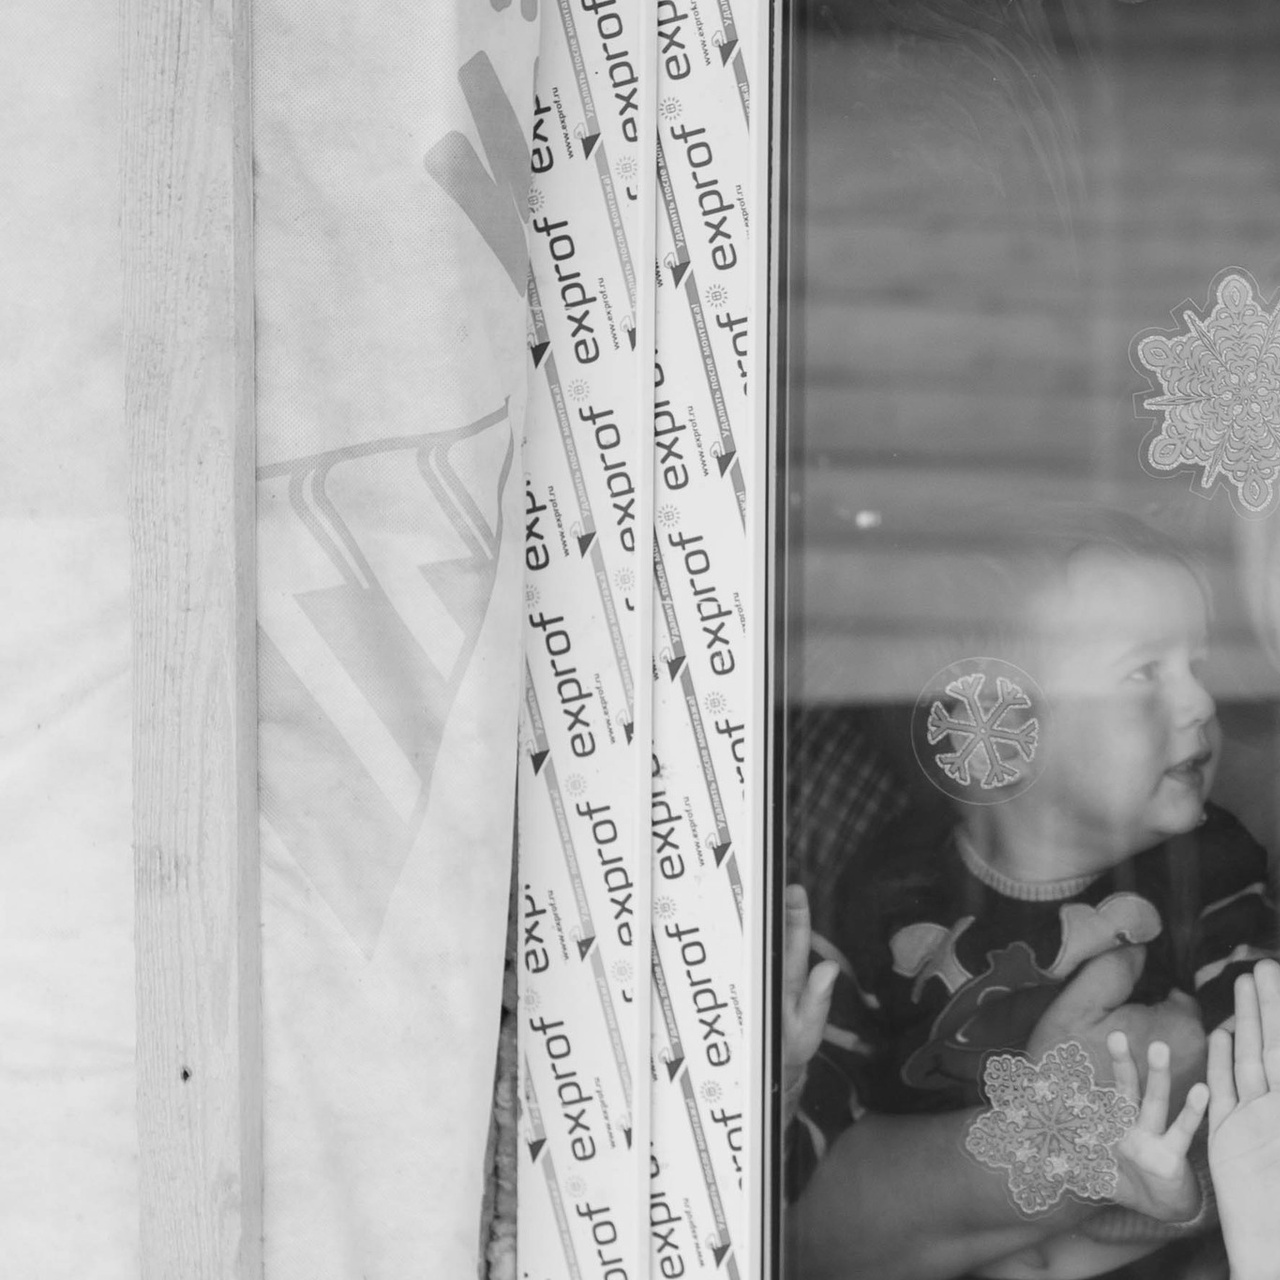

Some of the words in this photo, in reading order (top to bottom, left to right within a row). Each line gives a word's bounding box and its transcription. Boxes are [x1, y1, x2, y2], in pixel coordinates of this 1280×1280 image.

[569, 37, 583, 69] после
[551, 86, 575, 160] www.exprof.ru
[574, 70, 595, 120] Удалить
[601, 174, 620, 229] монтажа!
[671, 123, 738, 272] exprof
[533, 216, 600, 365] exprof
[597, 276, 620, 351] www.exprof.ru
[690, 303, 710, 356] монтажа!
[704, 357, 719, 390] после
[686, 405, 709, 477] www.exprof.ru
[711, 392, 730, 438] Удалить
[579, 405, 635, 553] exprof
[547, 485, 570, 557] www.exprof.ru
[668, 530, 735, 676] exprof
[529, 611, 597, 759] exprof
[594, 673, 616, 745] www.exprof.ru
[683, 796, 705, 867] www.exprof.ru
[576, 800, 634, 947] exprof
[665, 922, 731, 1068] exprof
[529, 1016, 597, 1162] exprof
